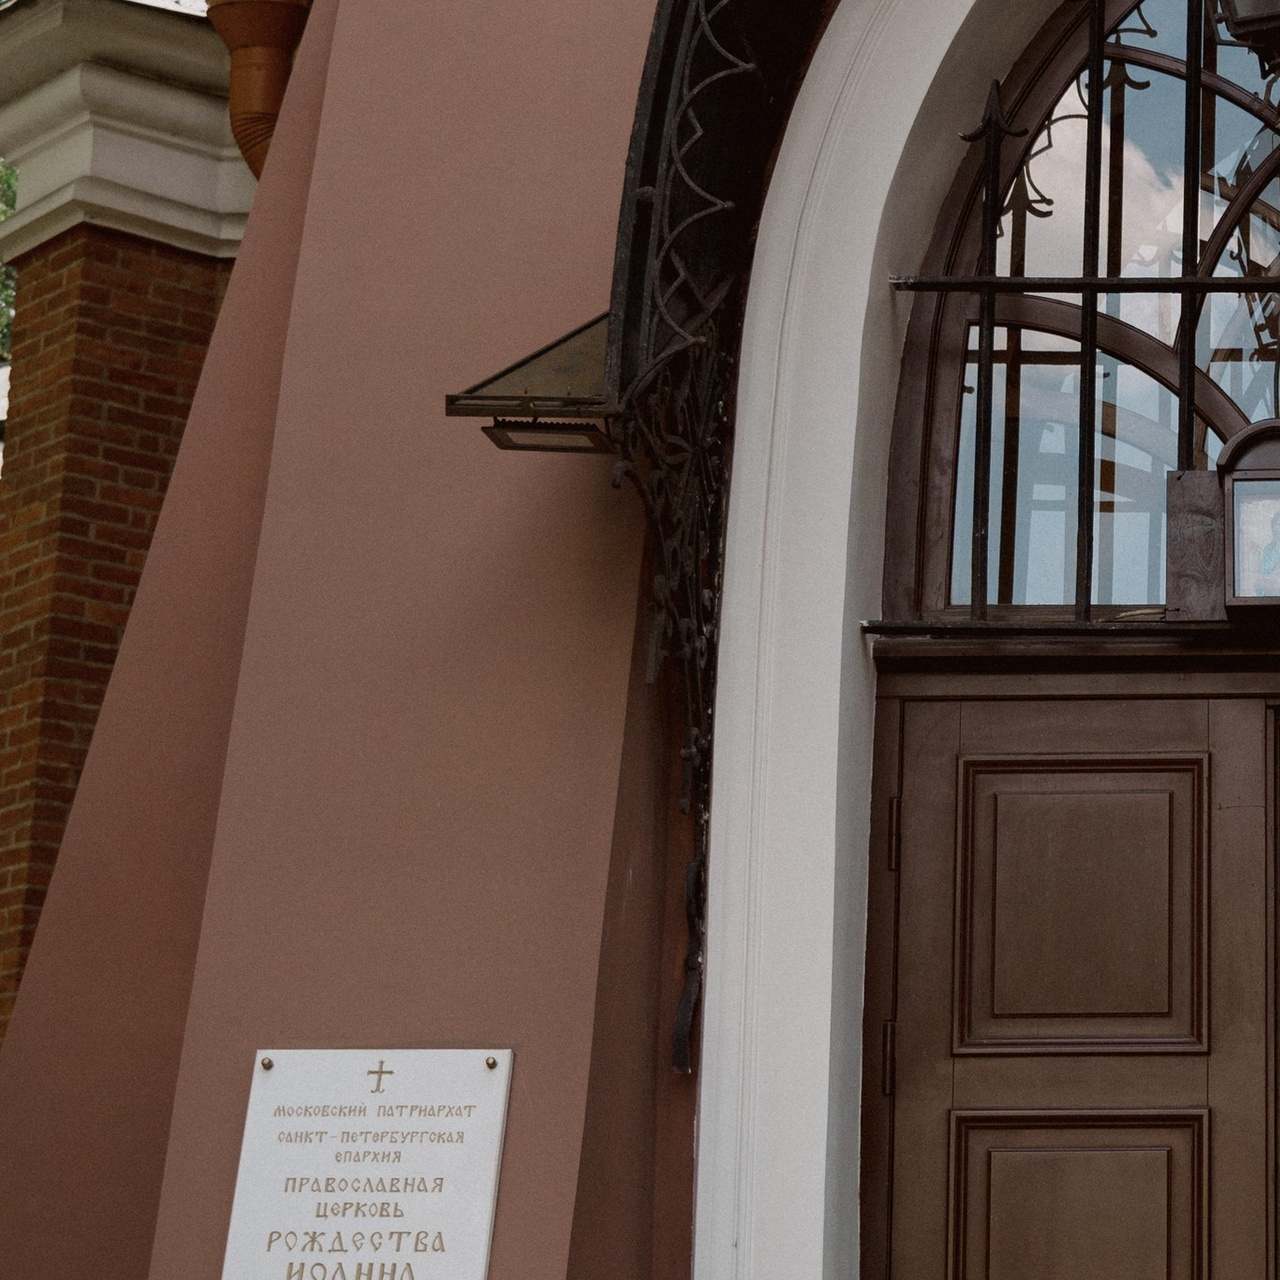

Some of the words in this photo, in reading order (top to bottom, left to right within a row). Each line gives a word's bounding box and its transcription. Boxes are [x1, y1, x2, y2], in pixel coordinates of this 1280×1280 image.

[335, 1150, 402, 1163] ЕПАРХИЯ
[284, 1177, 444, 1193] ПРАВОСЛАВНАЯ
[315, 1202, 405, 1220] ЦЕРКОВЬ
[266, 1230, 446, 1253] РОЖДЕСТВА
